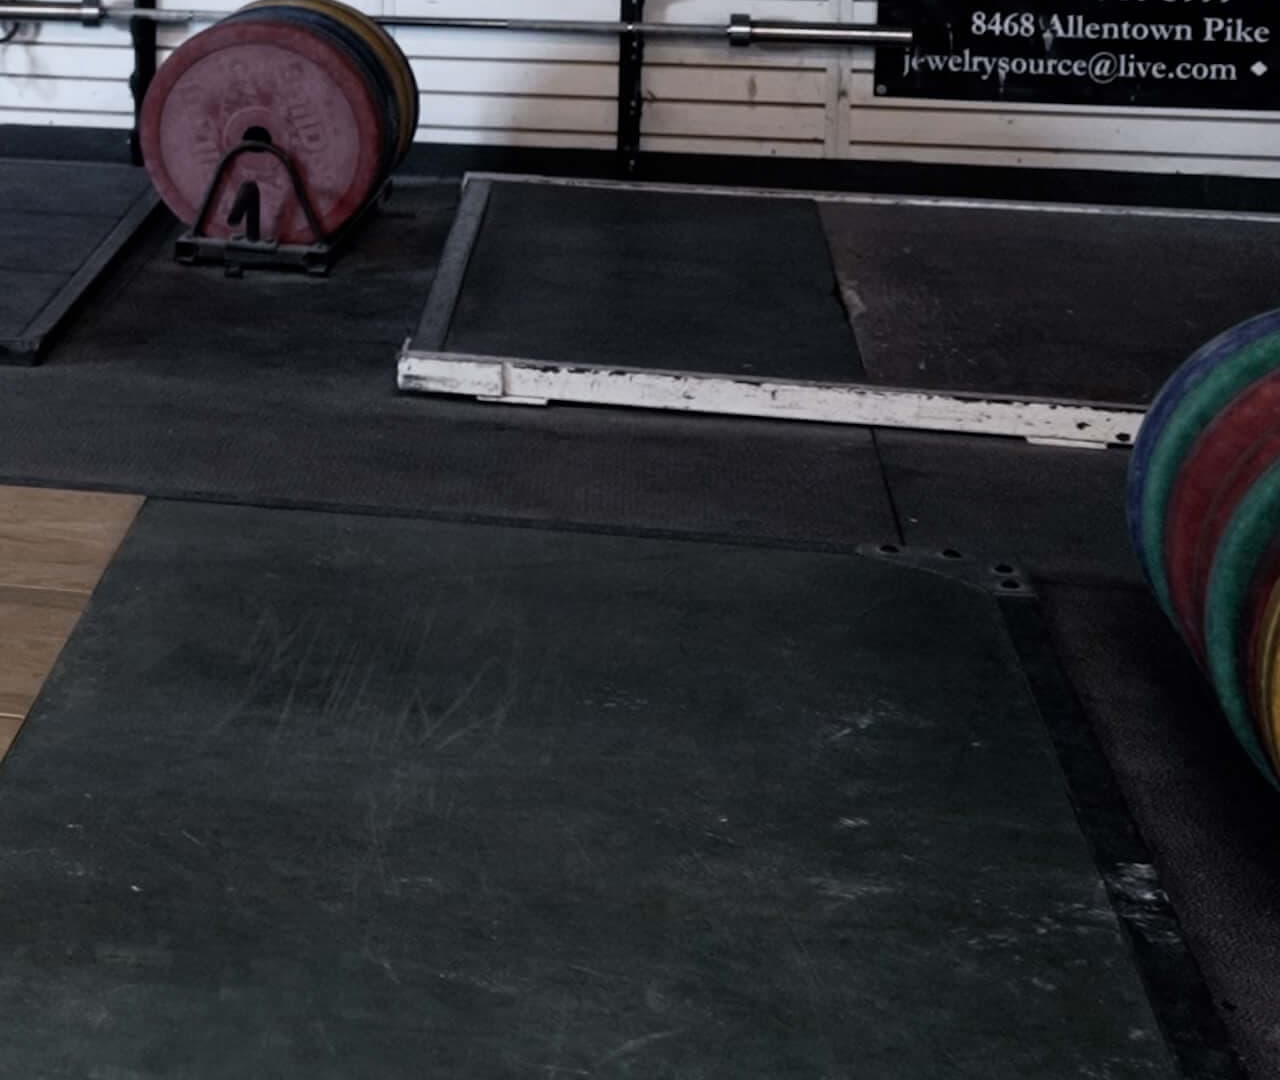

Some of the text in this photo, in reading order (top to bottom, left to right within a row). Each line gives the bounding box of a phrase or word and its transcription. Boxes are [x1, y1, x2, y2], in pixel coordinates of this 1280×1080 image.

[969, 9, 1270, 44] 8468 Allentown Pike
[902, 48, 1240, 86] jewelrysource@live.com
